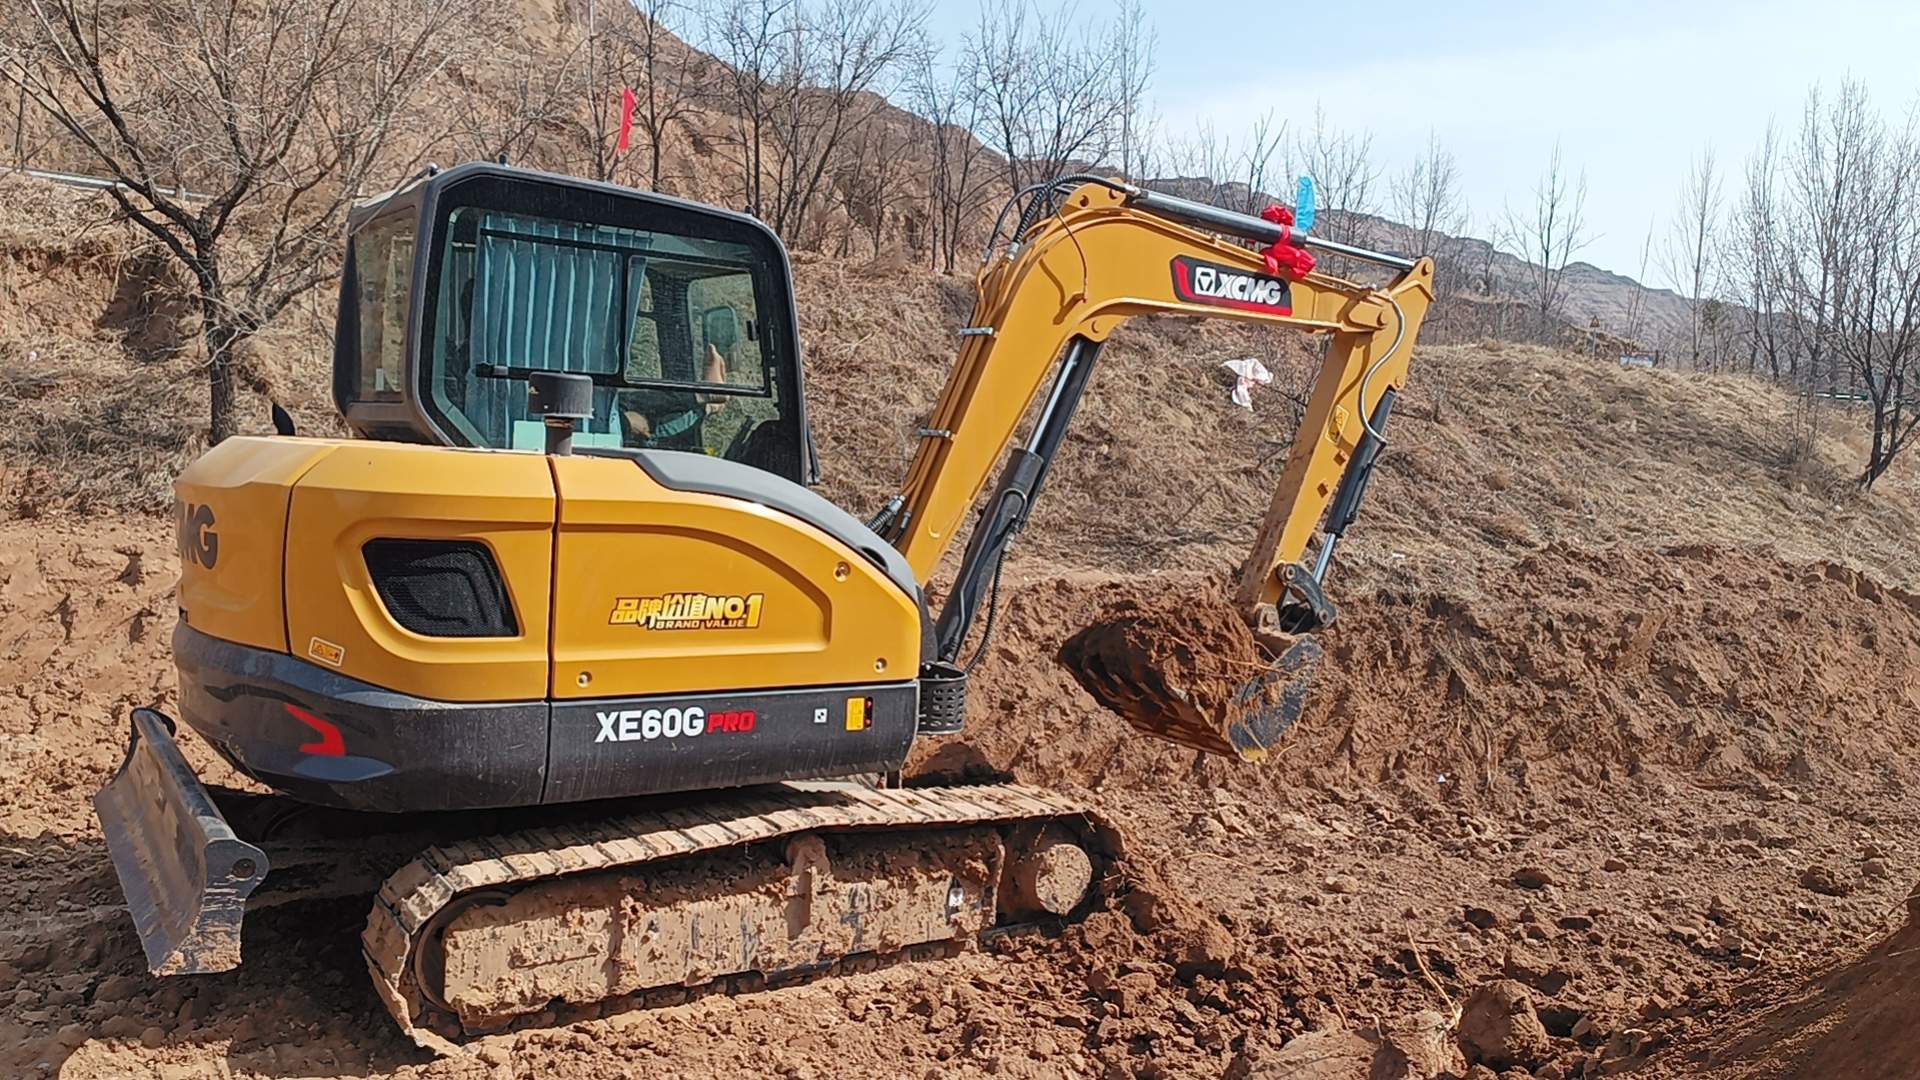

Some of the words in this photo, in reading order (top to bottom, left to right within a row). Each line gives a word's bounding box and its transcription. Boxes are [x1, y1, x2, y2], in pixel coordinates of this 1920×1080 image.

[1215, 274, 1281, 305] XCMG
[656, 619, 700, 629] BRAND
[705, 619, 745, 628] VALUE
[595, 707, 705, 743] XE60G
[707, 712, 755, 732] PRO
